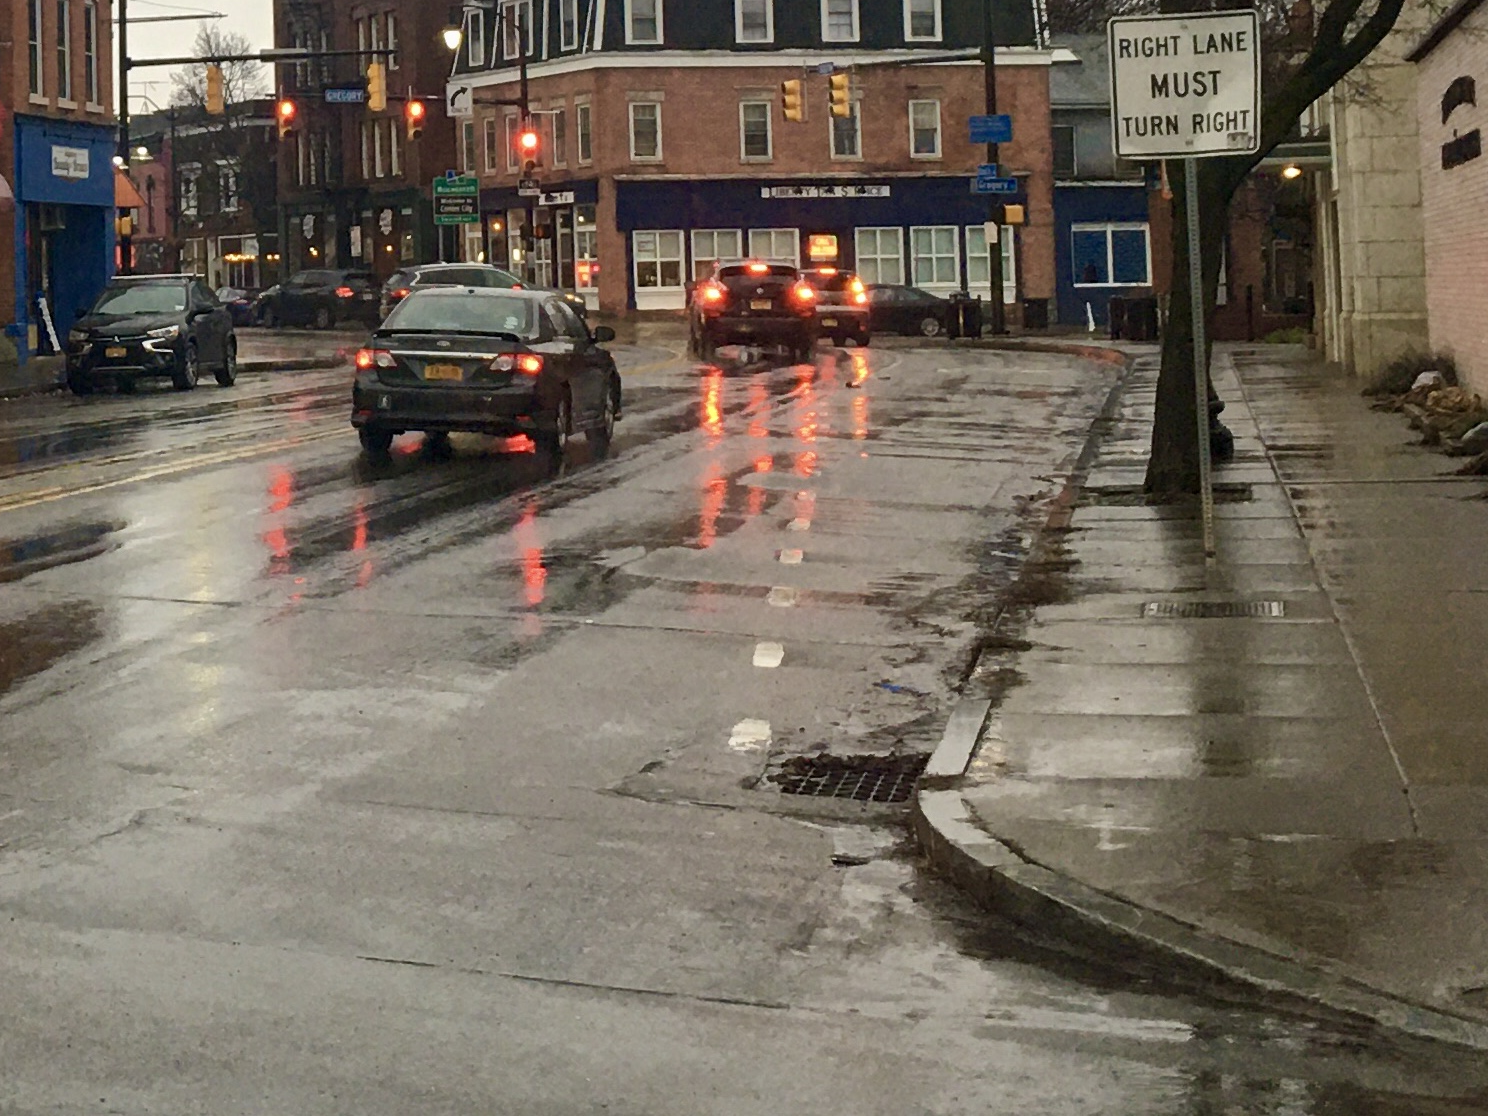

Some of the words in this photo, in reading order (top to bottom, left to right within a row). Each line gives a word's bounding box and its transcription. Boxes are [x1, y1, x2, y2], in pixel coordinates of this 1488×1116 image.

[1118, 35, 1181, 59] RIGHT
[1192, 30, 1248, 56] LANE
[1150, 69, 1222, 99] MUST
[1121, 114, 1180, 138] TURN
[1191, 109, 1251, 135] RIGHT
